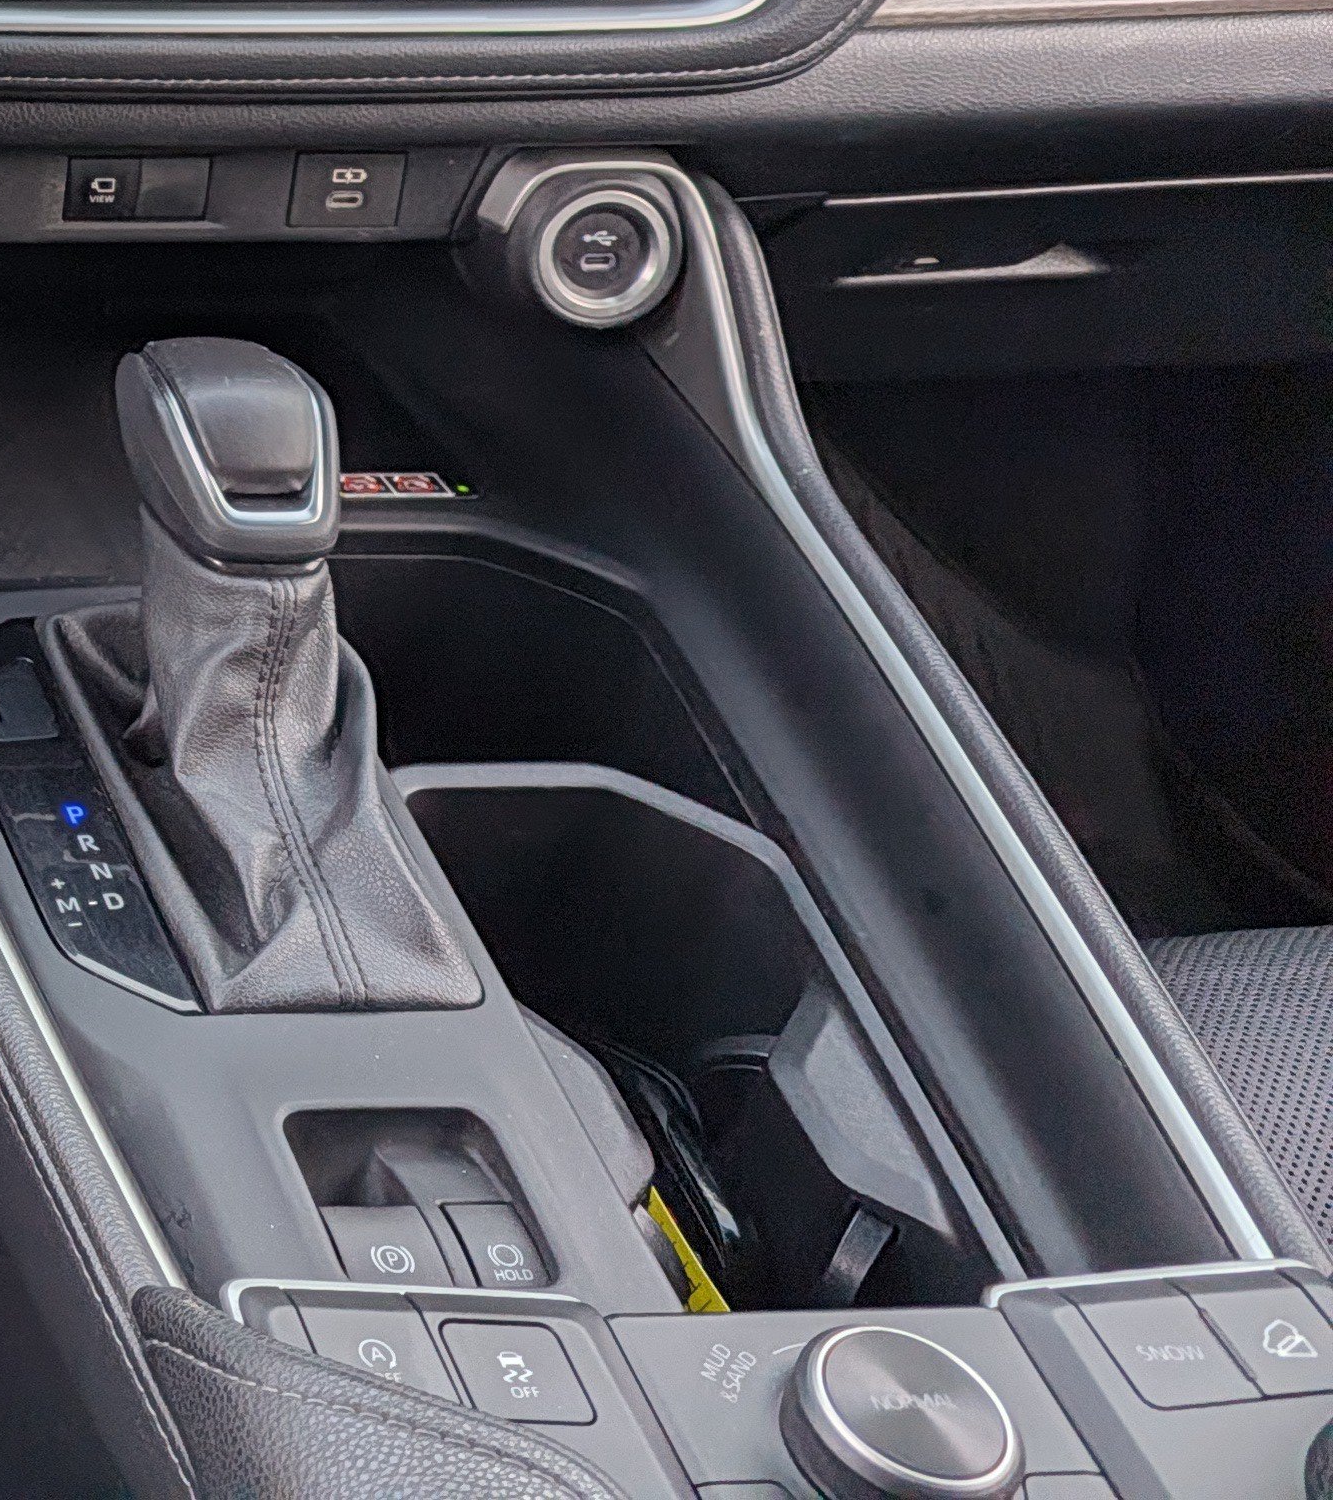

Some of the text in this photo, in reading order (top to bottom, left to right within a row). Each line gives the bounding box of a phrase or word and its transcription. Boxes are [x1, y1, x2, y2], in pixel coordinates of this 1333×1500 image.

[89, 194, 114, 203] VIEW
[66, 805, 84, 824] P
[76, 834, 100, 851] R
[89, 863, 113, 879] N
[55, 892, 124, 913] M D
[494, 1269, 533, 1281] HOLD
[1135, 1344, 1204, 1360] SNOW
[700, 1343, 730, 1381] MUD
[510, 1386, 539, 1398] OFF
